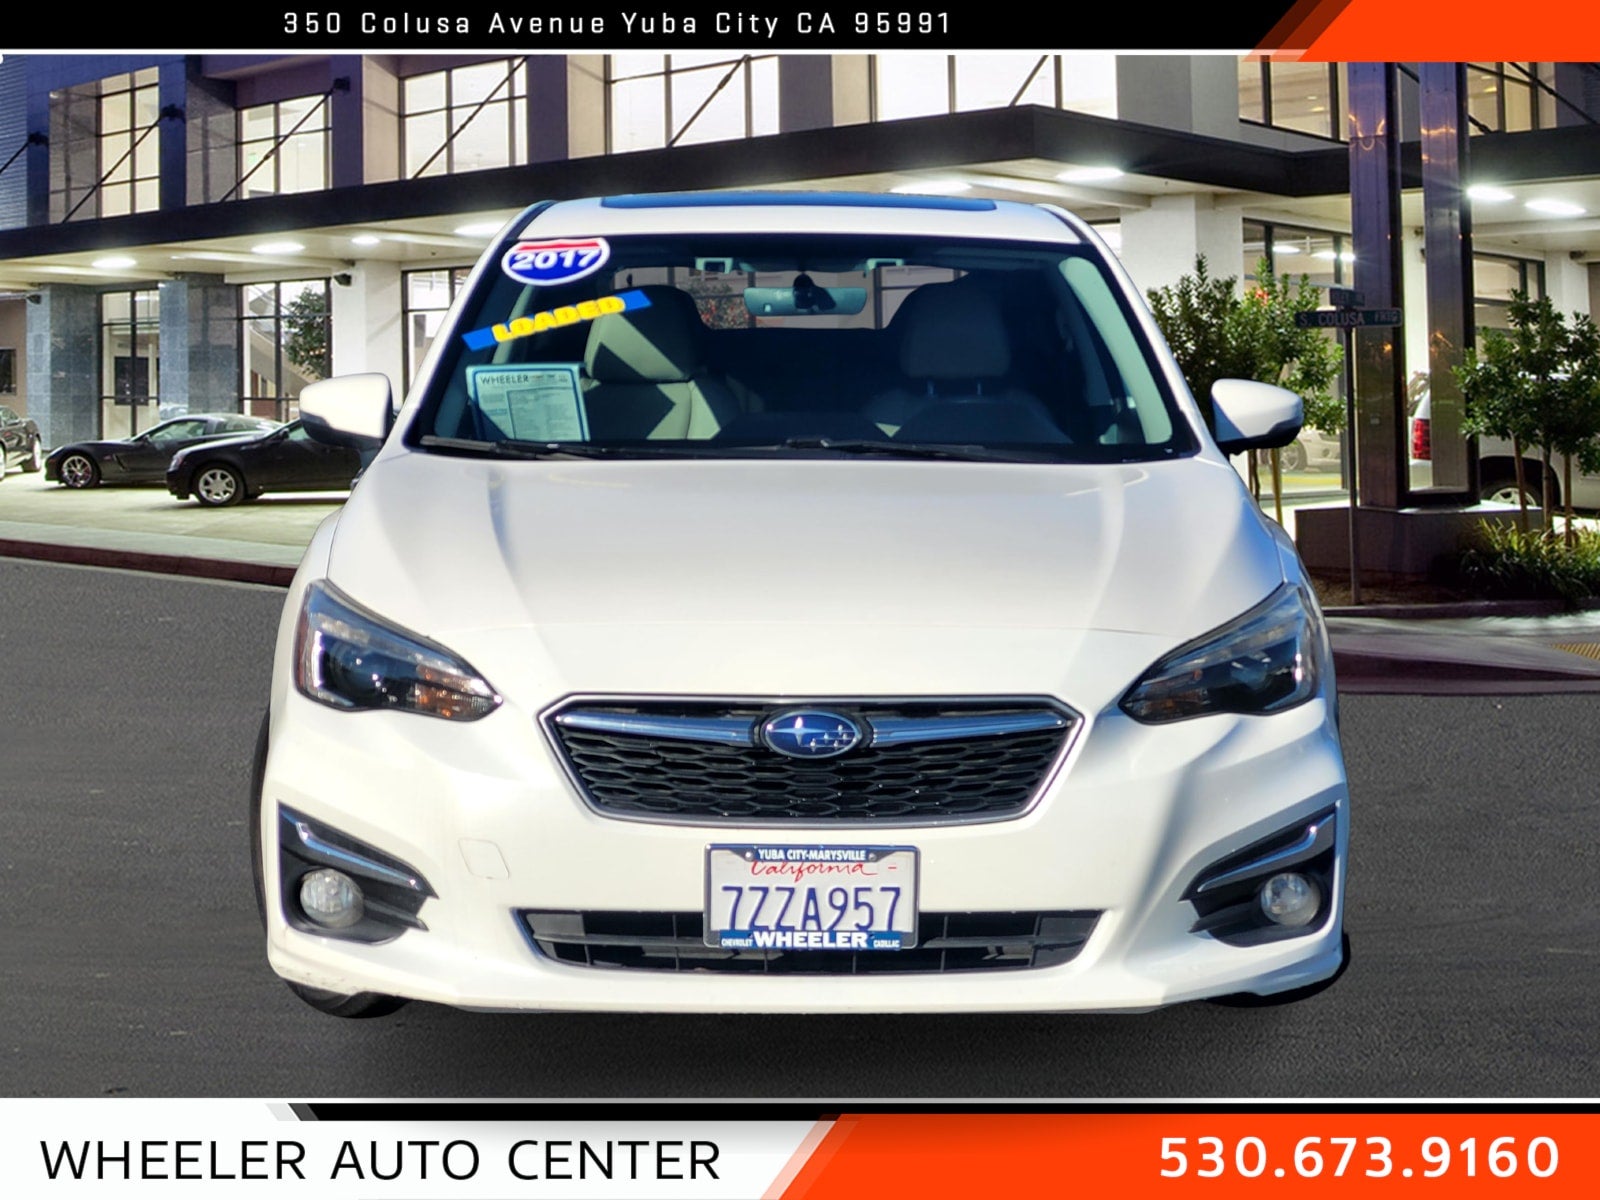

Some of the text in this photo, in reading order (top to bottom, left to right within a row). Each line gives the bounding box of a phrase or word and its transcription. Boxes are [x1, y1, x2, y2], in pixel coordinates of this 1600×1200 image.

[510, 249, 602, 270] 2017
[491, 295, 626, 342] LOADED
[1318, 312, 1366, 326] COLUSA
[480, 374, 529, 386] WHEELER
[757, 848, 867, 861] YUBA CITY-MARYSVILLE
[751, 860, 878, 883] California
[721, 885, 902, 932] 7ZZA957
[752, 931, 869, 948] WHEELER
